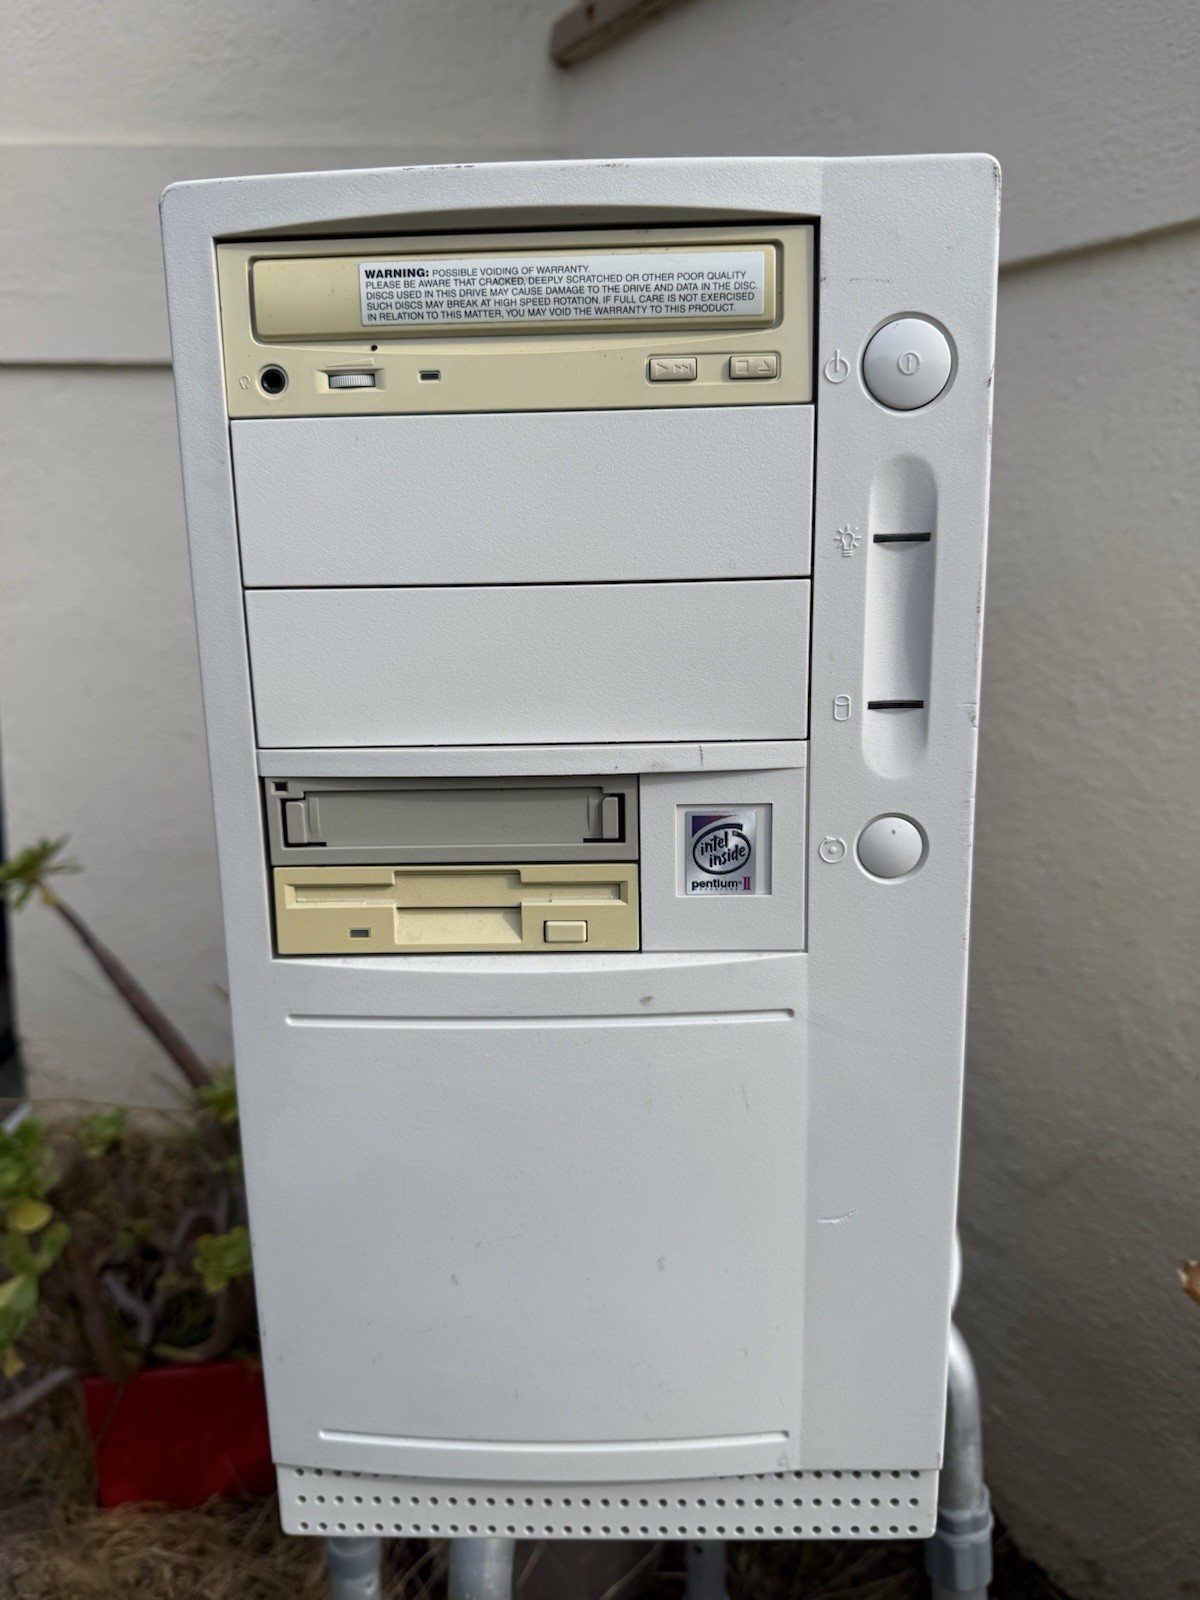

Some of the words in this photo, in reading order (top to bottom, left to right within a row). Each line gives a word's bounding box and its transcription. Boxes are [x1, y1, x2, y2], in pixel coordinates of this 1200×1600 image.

[365, 268, 429, 279] WARNING:
[432, 268, 477, 277] POSSIBLE
[480, 267, 518, 276] VOIDING
[522, 267, 534, 275] OF
[536, 265, 590, 274] WARRANTY.
[366, 280, 401, 289] PLEASE
[404, 280, 416, 289] BE
[419, 279, 451, 288] AWARE
[453, 278, 477, 287] THAT
[479, 277, 526, 287] CRACKED,
[529, 276, 563, 285] DEEPLY
[566, 274, 622, 284] SCRATCHED
[625, 273, 639, 282] OR
[642, 272, 674, 282] OTHER
[677, 272, 704, 281] POOR
[707, 271, 746, 280] QUALITY
[366, 291, 394, 300] DISCS
[397, 290, 422, 299] USED
[424, 290, 433, 298] IN
[435, 289, 456, 298] THIS
[459, 288, 487, 297] DRIVE
[490, 288, 508, 296] MAY
[511, 287, 542, 296] CAUSE
[546, 285, 585, 295] DAMAGE
[588, 285, 599, 294] TO
[602, 284, 620, 293] THE
[623, 283, 651, 292] DRIVE
[653, 283, 673, 292] AND
[676, 282, 698, 291] DATA
[701, 282, 710, 290] IN
[712, 282, 732, 290] THE
[734, 281, 758, 290] DISC.
[367, 301, 392, 311] SUCH
[395, 301, 423, 310] DISCS
[425, 301, 444, 309] MAY
[447, 299, 478, 308] BREAK
[481, 299, 492, 307] AT
[494, 298, 517, 307] HIGH
[519, 297, 550, 307] SPEED
[553, 295, 600, 306] ROTATION.
[603, 295, 612, 304] IF
[614, 294, 636, 303] FULL
[639, 293, 665, 303] CARE
[667, 293, 676, 302] IS
[679, 293, 698, 302] NOT
[701, 292, 754, 301] EXERCISED
[368, 313, 377, 321] IN
[380, 311, 424, 321] RELATION
[426, 310, 439, 319] TO
[442, 310, 462, 319] THIS
[464, 308, 504, 319] MATTER,
[506, 308, 525, 317] YOU
[528, 307, 546, 317] MAY
[549, 305, 572, 316] VOID
[574, 306, 592, 316] THE
[595, 305, 647, 315] WARRANTY
[650, 305, 662, 313] TO
[664, 304, 686, 313] THIS
[688, 303, 736, 313] PRODUCT.
[700, 831, 728, 856] intel
[709, 844, 746, 868] inside
